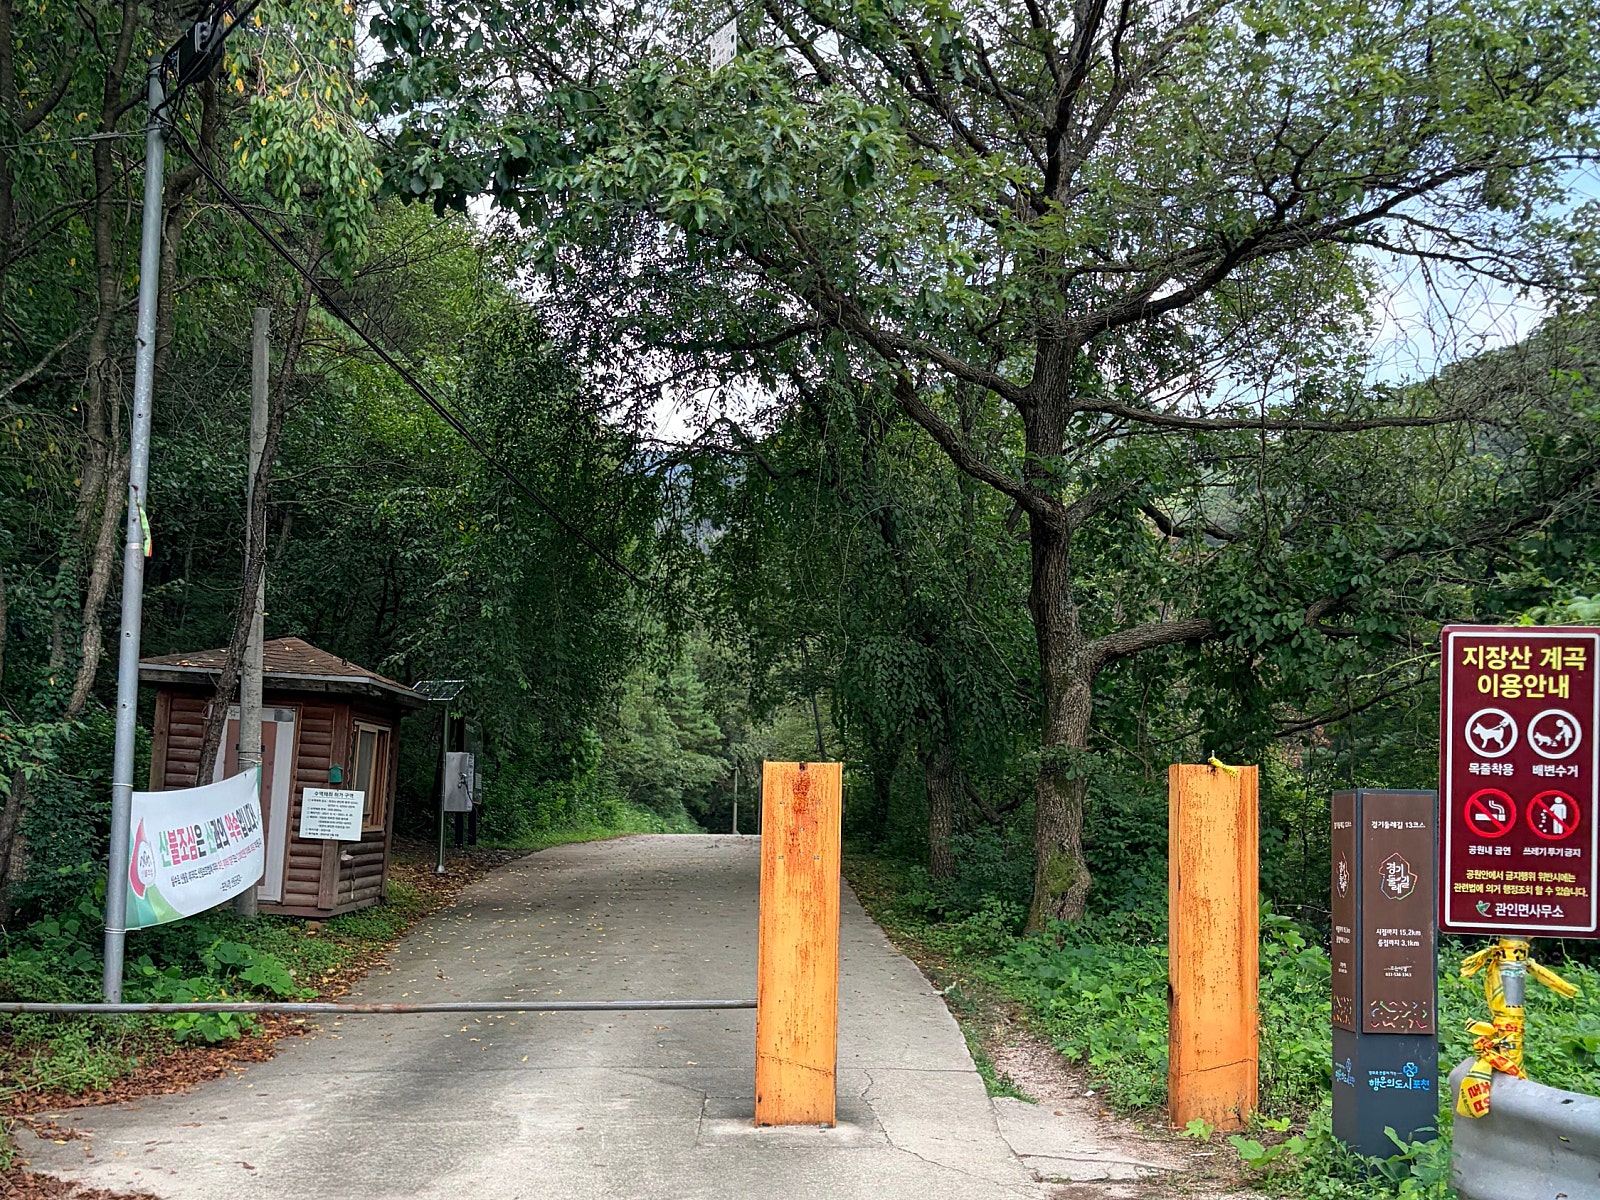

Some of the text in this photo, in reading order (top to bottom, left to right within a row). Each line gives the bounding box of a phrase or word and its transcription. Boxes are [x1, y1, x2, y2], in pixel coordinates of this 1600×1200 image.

[1462, 645, 1588, 672] 지장산 계곡
[1477, 674, 1570, 699] 이용안내
[1468, 762, 1514, 777] 목줄착용
[1532, 764, 1579, 778] 배변수거
[1371, 821, 1426, 830] 경기둘레길 13코스
[158, 824, 207, 868] 산불조심은
[1468, 845, 1512, 857] 공원내 금연
[1523, 847, 1547, 857] 쓰레기
[1564, 848, 1581, 858] 금지
[1466, 869, 1577, 883] 공원안에서 금지행위 위반시에는
[1453, 882, 1589, 898] 관련법에 의거 행정조치 할 수 있습니다.
[1495, 902, 1565, 919] 관인면사무소
[1376, 928, 1398, 937] 시점까지
[1377, 939, 1420, 948] 종점까지 3.1km
[1368, 1076, 1430, 1092] 행운의도시 포천
